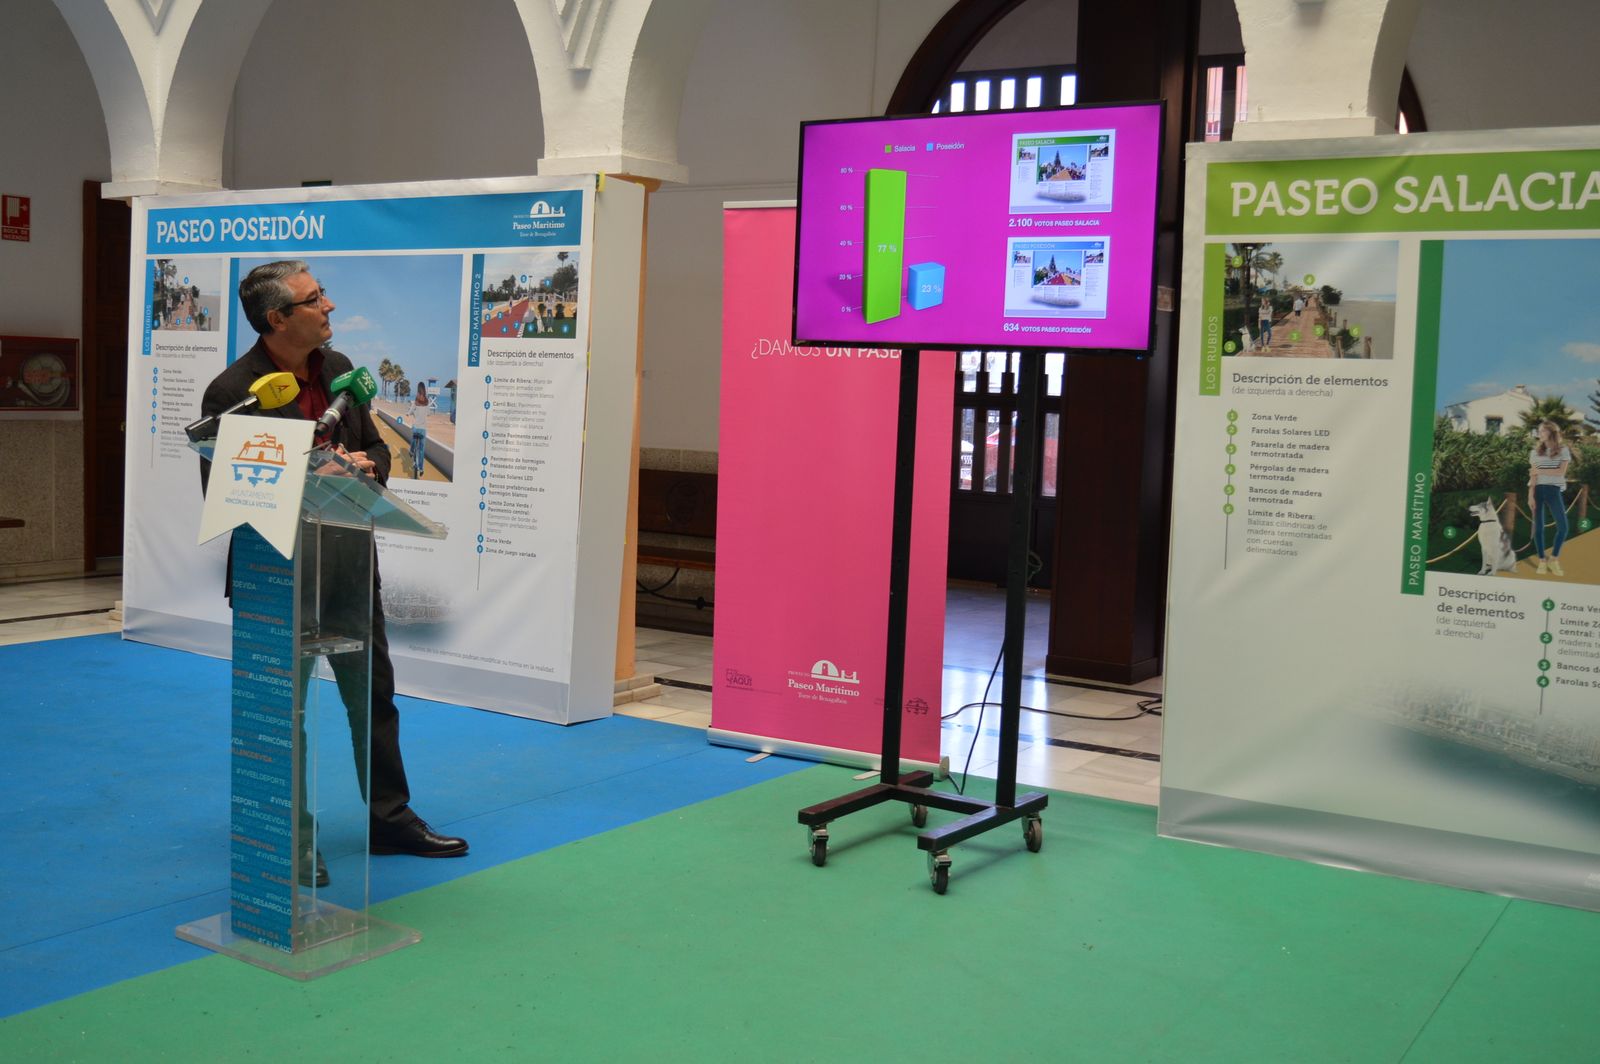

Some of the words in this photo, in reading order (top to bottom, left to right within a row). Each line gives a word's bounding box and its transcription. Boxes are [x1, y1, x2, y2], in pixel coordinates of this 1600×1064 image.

[894, 145, 916, 153] Salacia
[936, 142, 965, 151] Poseidón
[1231, 178, 1379, 218] PASEO
[1393, 171, 1600, 214] SALACIA
[157, 219, 214, 243] PASEO
[220, 210, 325, 241] POSEIDÓN
[1009, 218, 1032, 227] 2.100
[878, 245, 887, 253] 77
[889, 245, 897, 253] %
[922, 285, 931, 293] 23
[934, 285, 942, 293] %
[1004, 323, 1019, 332] 634
[1207, 315, 1218, 362] RUBIOS
[487, 350, 527, 358] Descripción
[539, 351, 574, 359] elementos
[1205, 366, 1217, 390] LOS
[1233, 373, 1302, 389] Descripción
[1306, 376, 1321, 385] de
[1324, 376, 1389, 387] elementos
[1232, 386, 1245, 395] (de
[1248, 387, 1286, 397] izquierda
[1296, 388, 1333, 398] derecha)
[1275, 414, 1298, 422] Verde
[1251, 427, 1280, 435] Farolas
[1282, 428, 1312, 436] Solares
[1251, 441, 1284, 449] Pasarela
[1287, 442, 1296, 450] de
[1299, 443, 1330, 451] madera
[1251, 451, 1303, 459] termotratada
[1250, 463, 1284, 473] Pérgolas
[1249, 473, 1295, 482] termotrada
[506, 484, 538, 492] prefabricados
[1249, 487, 1278, 495] Bancos
[256, 501, 277, 509] VICTORIA
[1248, 496, 1294, 505] termotrada
[1412, 472, 1426, 540] MARÍTIMO
[1248, 509, 1273, 517] Límite
[1288, 512, 1315, 520] Ribera:
[1317, 523, 1327, 531] de
[1247, 528, 1275, 536] madera
[1263, 539, 1293, 547] cuerdas
[1246, 546, 1298, 556] delimitadoras
[1409, 544, 1420, 585] PASEO
[1438, 586, 1516, 603] Descripción
[1437, 603, 1453, 613] de
[1457, 604, 1525, 620] elementos
[1560, 603, 1584, 611] Zona
[1436, 616, 1451, 625] (de
[1453, 618, 1496, 629] izquierda
[1560, 618, 1590, 627] Límite
[1443, 628, 1484, 641] derecha)
[1559, 629, 1595, 637] central:
[1558, 639, 1592, 648] madera
[252, 654, 280, 665] #FUTURO
[1557, 662, 1590, 672] Bancos
[248, 673, 294, 688] #LLENODEVIDA
[788, 678, 814, 690] Paseo
[1555, 677, 1589, 687] Farolas
[236, 768, 286, 786] #VIVEELDEPORTE
